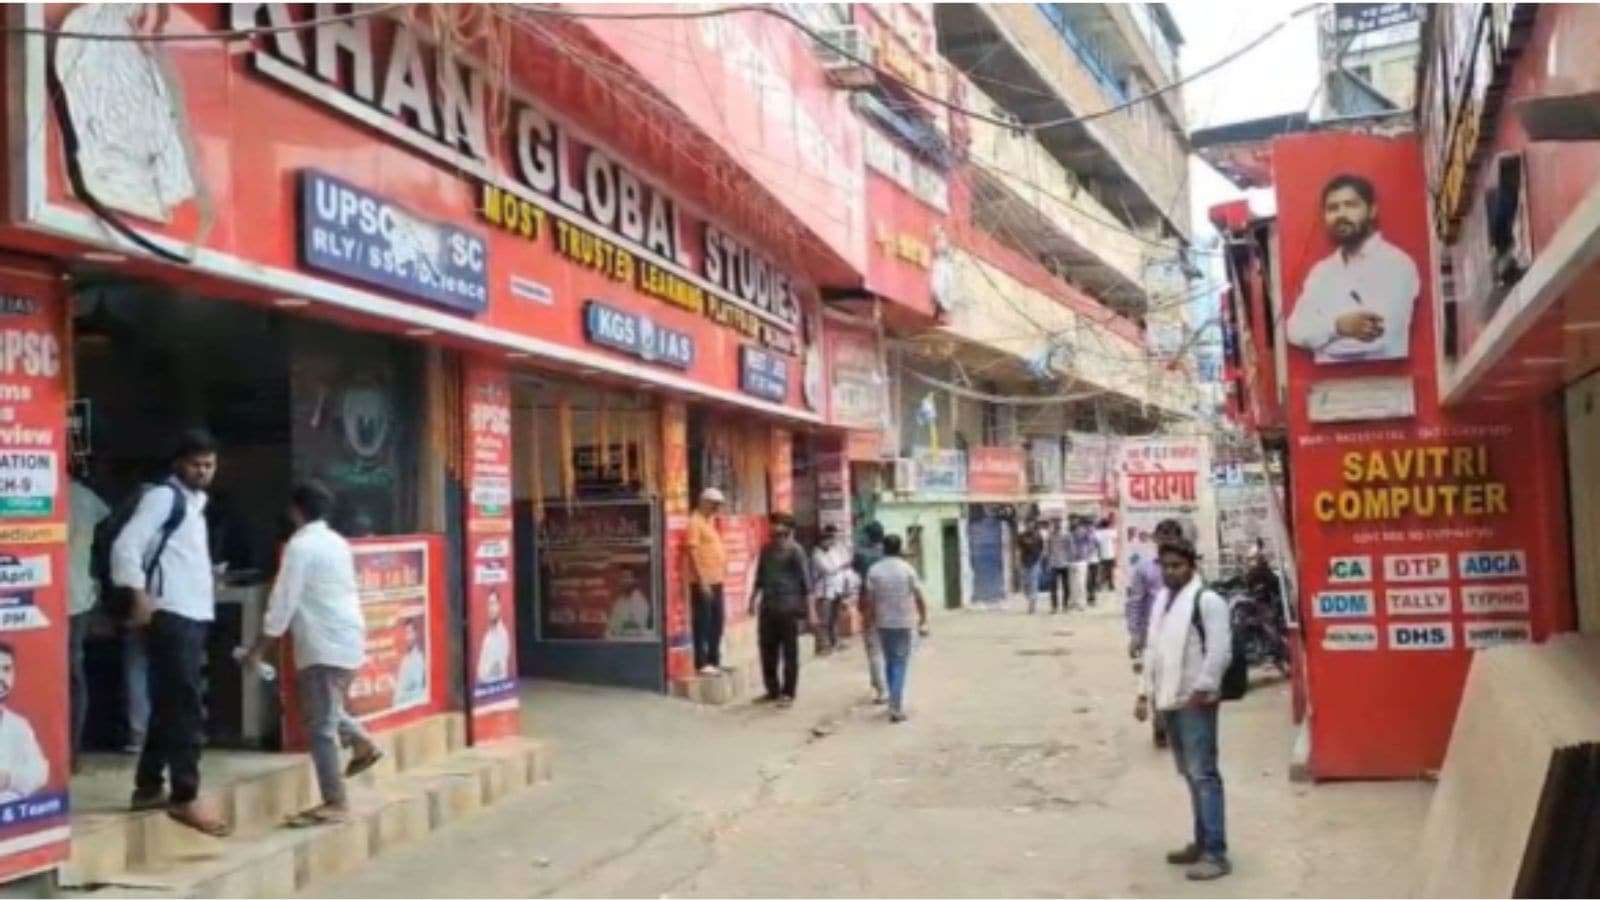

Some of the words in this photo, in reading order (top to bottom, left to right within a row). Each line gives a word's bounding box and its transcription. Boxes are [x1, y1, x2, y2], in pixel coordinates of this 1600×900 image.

[517, 108, 692, 269] GLOBAL
[704, 226, 799, 325] STUDIES
[484, 185, 546, 240] MOST
[557, 219, 634, 284] TRUSTED
[599, 307, 635, 345] KGS
[660, 328, 691, 363] IAS
[0, 329, 60, 378] PSC
[0, 455, 50, 471] ATION
[1343, 444, 1488, 482] SAVITRI
[1128, 463, 1197, 502] दारोगा
[1314, 482, 1509, 522] COMPUTER
[0, 526, 53, 542] edium
[1328, 561, 1365, 579] CA
[1394, 558, 1442, 577] DTP
[1464, 555, 1521, 574] ADCA
[1319, 594, 1368, 613] DDM
[1389, 593, 1446, 610] TALLY
[1395, 627, 1446, 646] DHS
